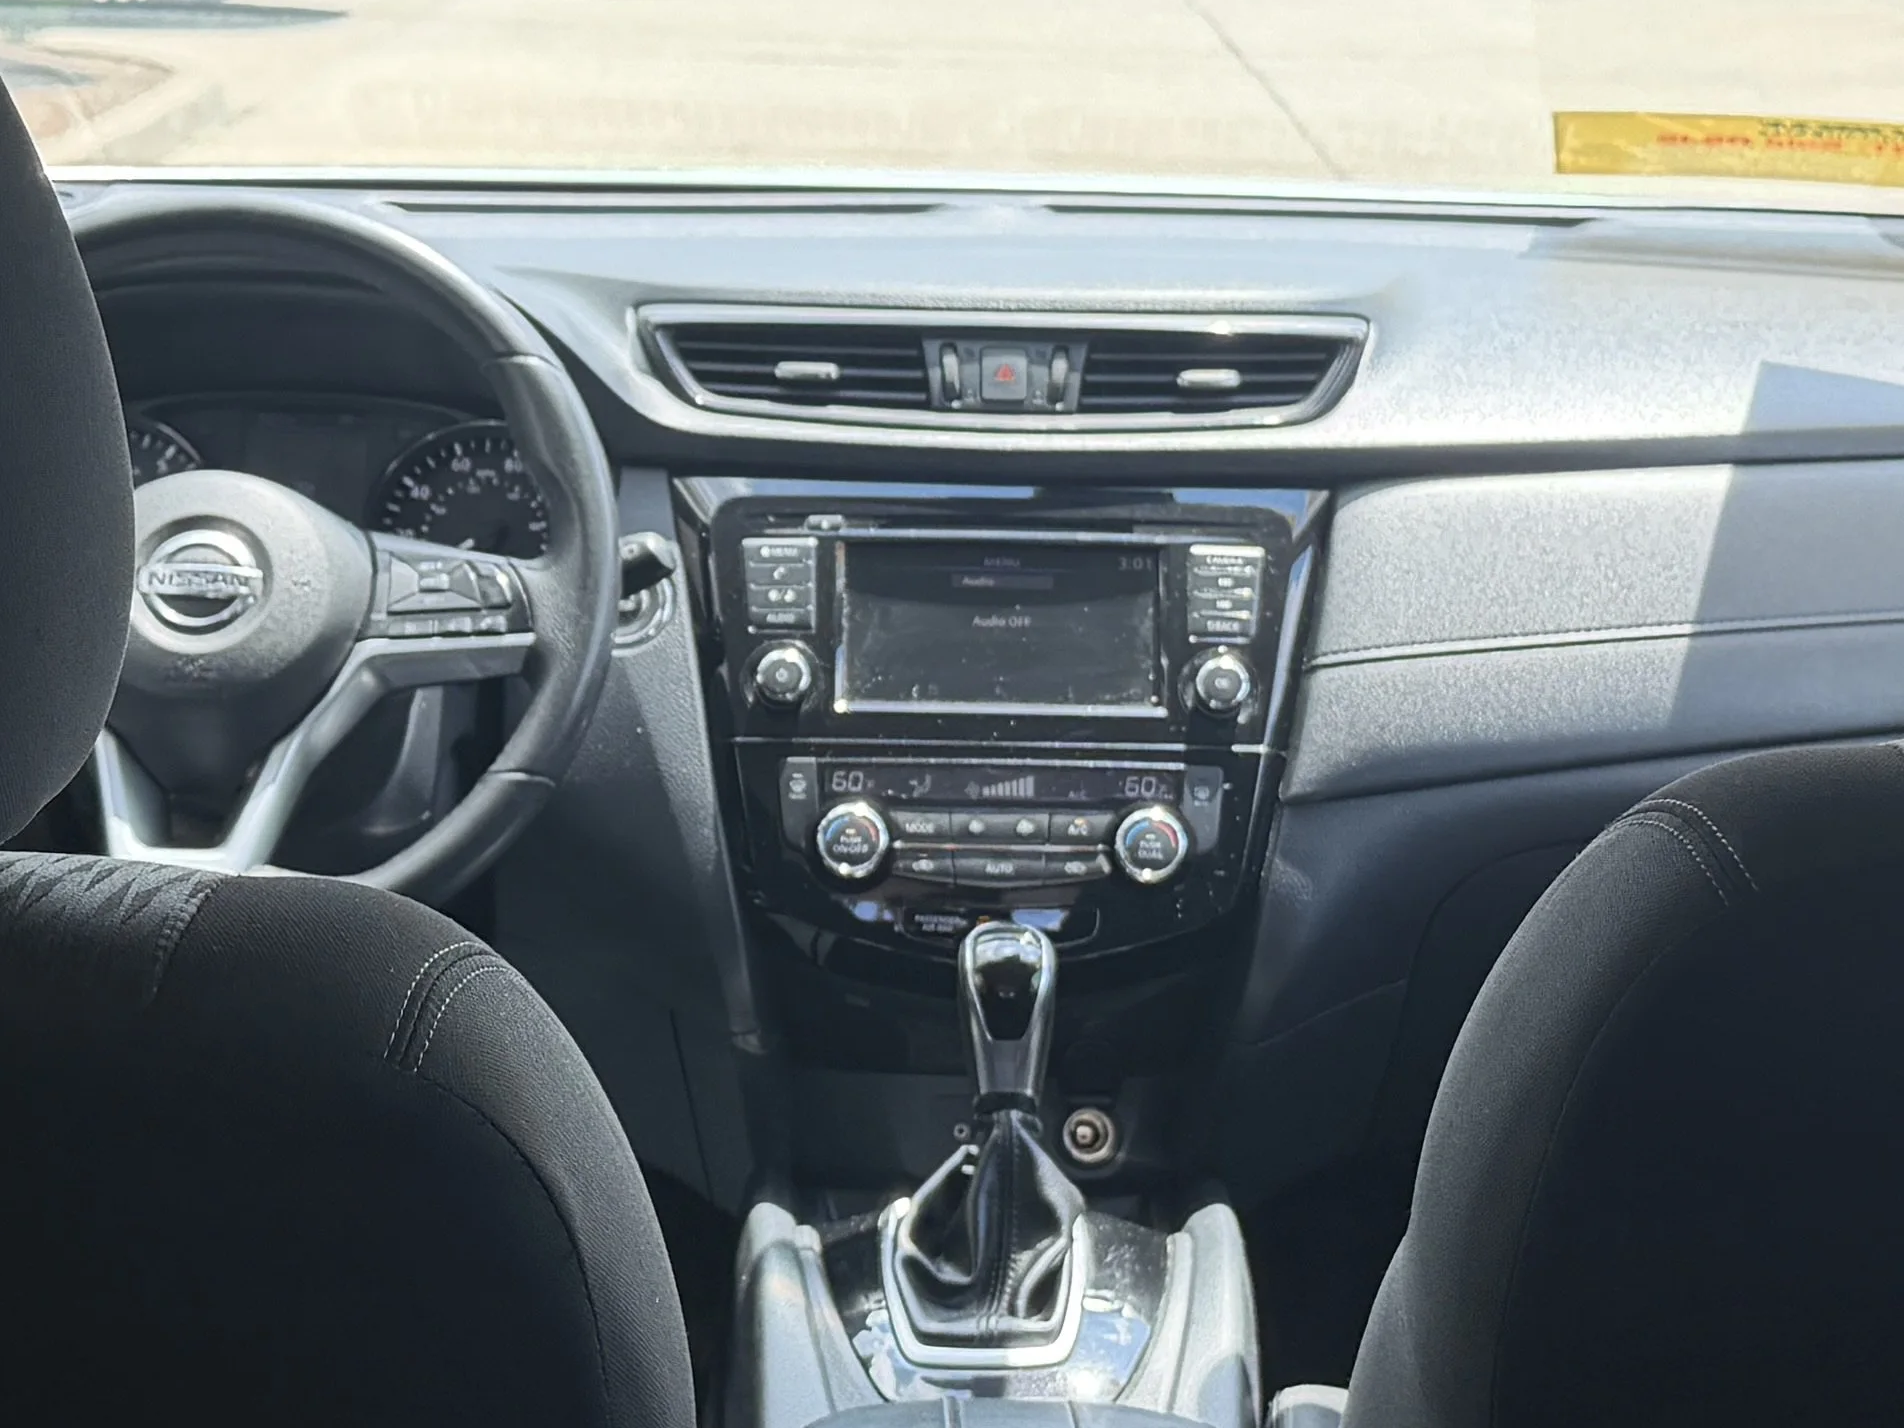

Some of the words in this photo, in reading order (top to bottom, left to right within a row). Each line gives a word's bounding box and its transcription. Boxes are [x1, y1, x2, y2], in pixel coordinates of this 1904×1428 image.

[148, 571, 252, 588] NISSAN
[971, 614, 1007, 628] Audio
[1007, 615, 1032, 629] OFF
[832, 771, 864, 793] 60
[1124, 776, 1157, 798] 60
[905, 822, 936, 835] MODE
[984, 862, 1015, 875] AUTO
